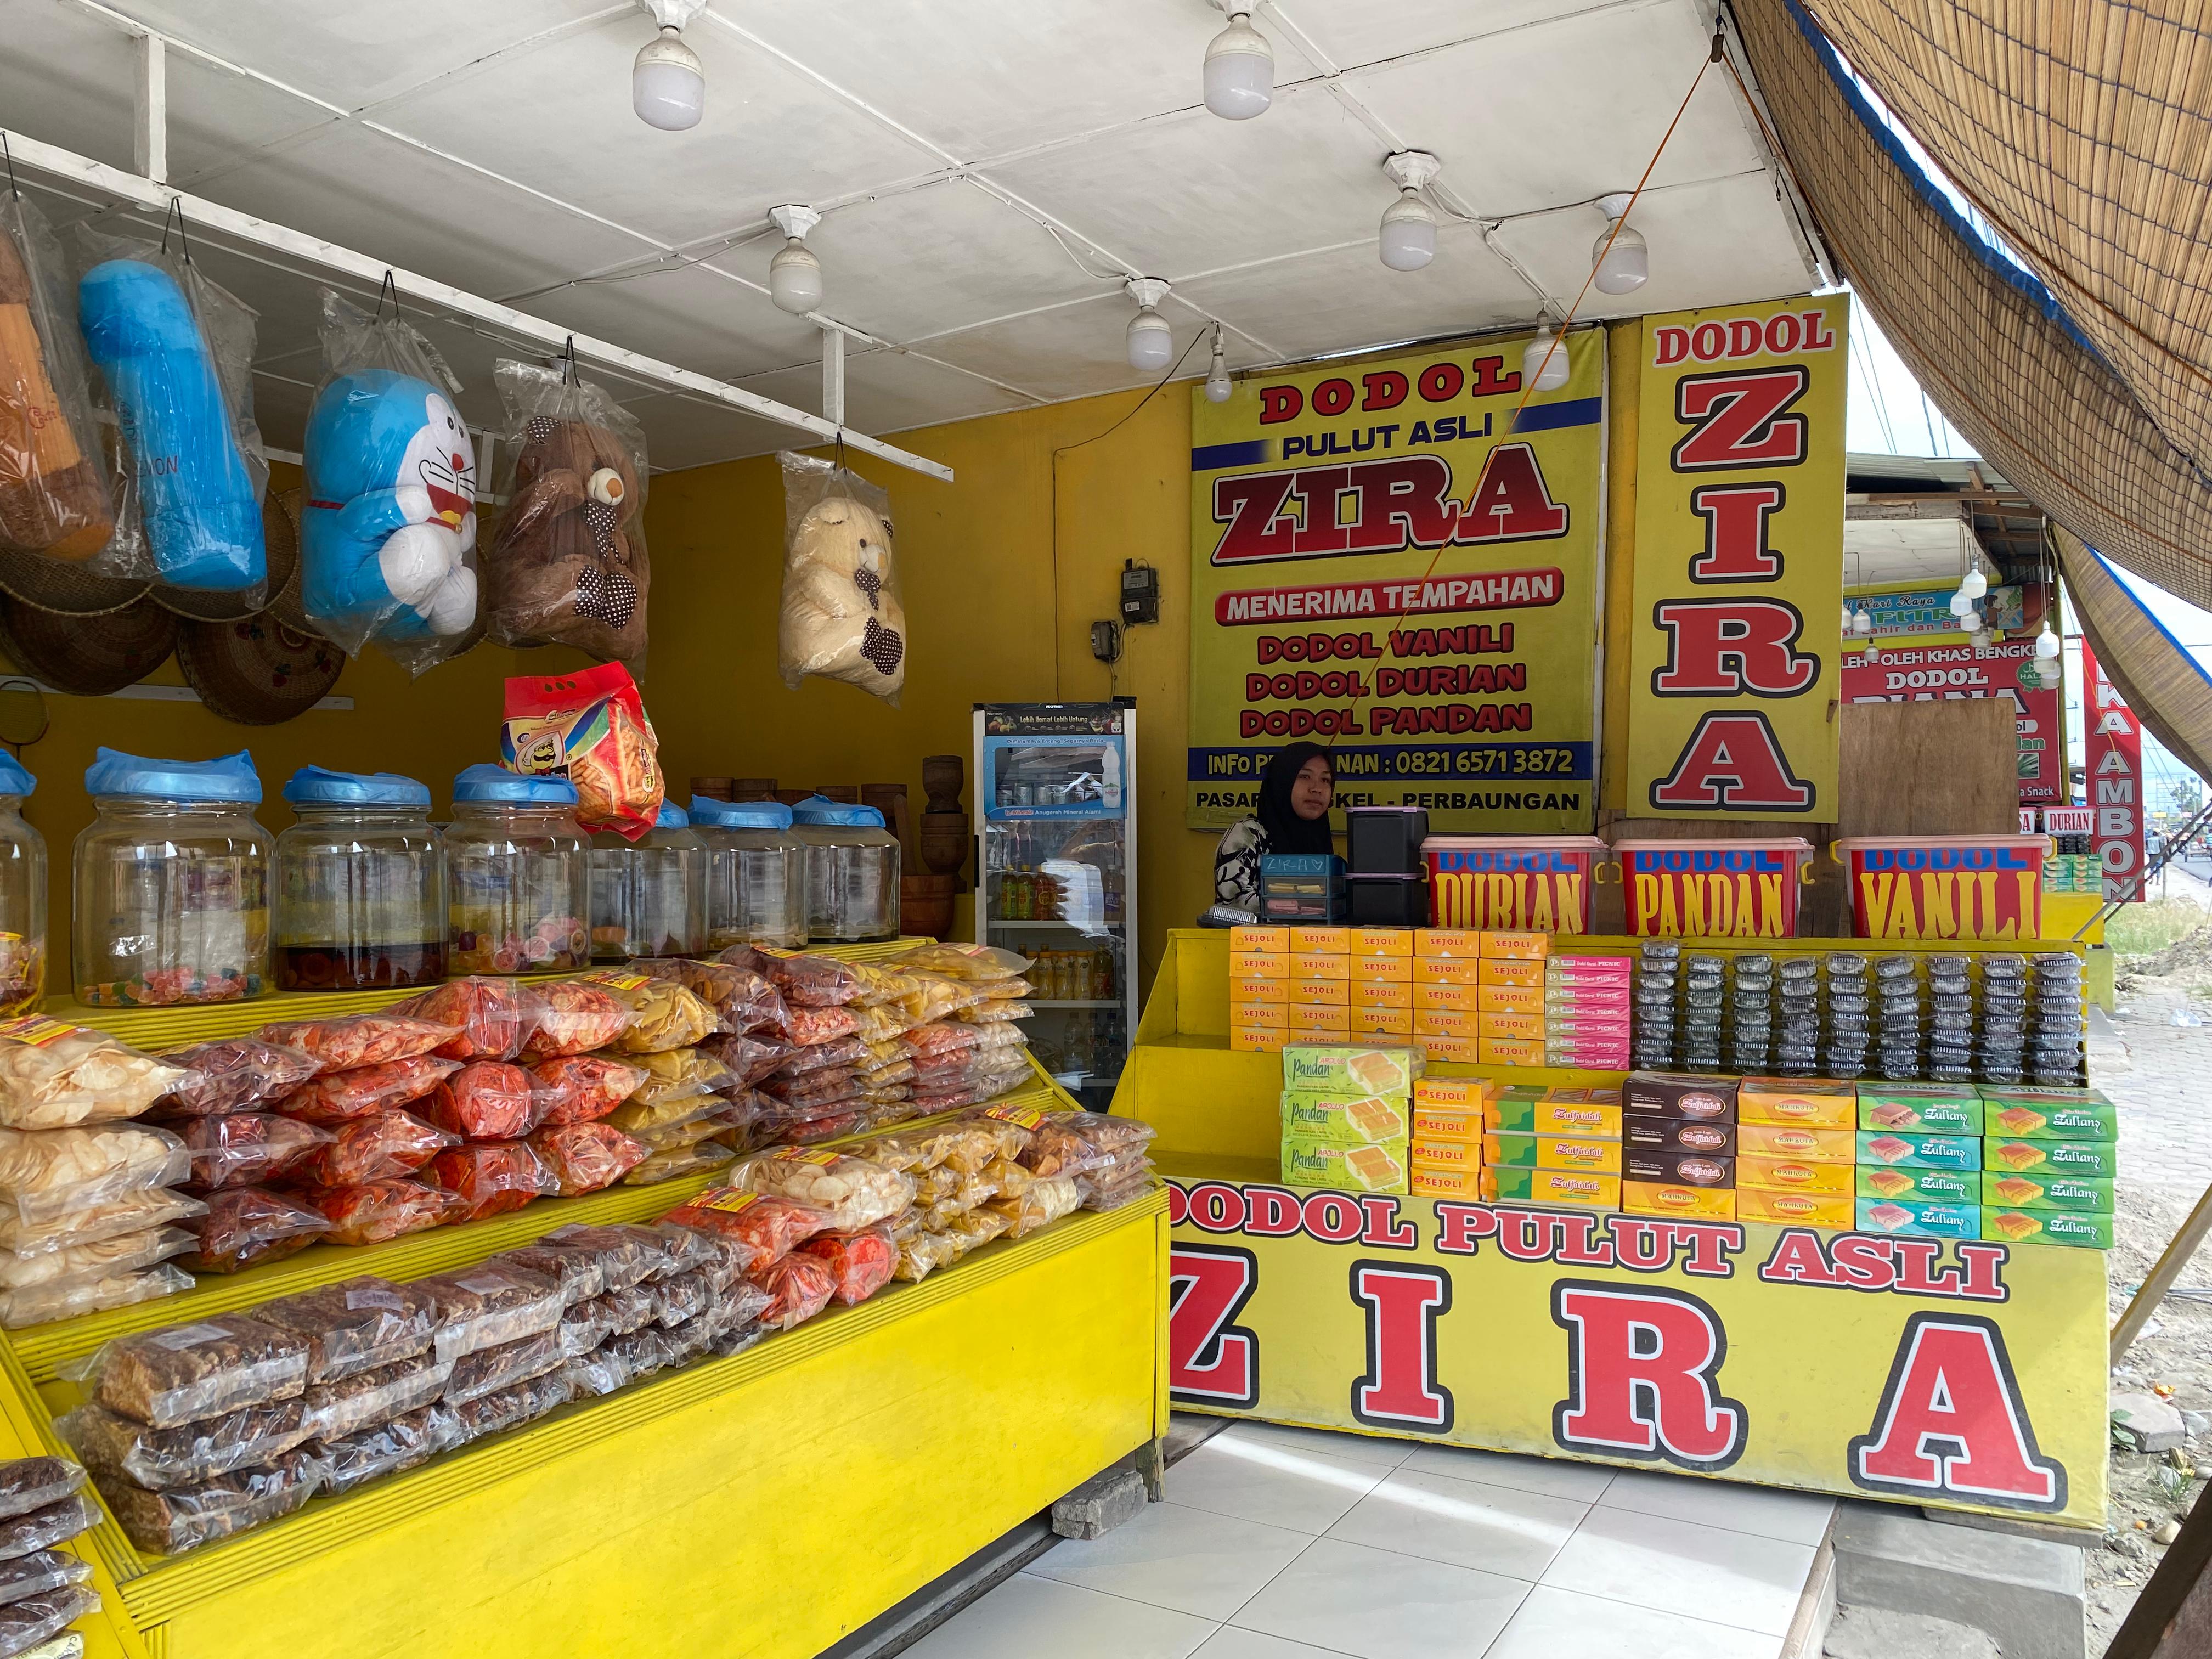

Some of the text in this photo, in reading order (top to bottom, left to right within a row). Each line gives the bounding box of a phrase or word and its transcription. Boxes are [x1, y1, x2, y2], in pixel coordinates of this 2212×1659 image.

[1654, 309, 1835, 367] DODOL
[1259, 355, 1522, 425] DODOL
[1283, 413, 1492, 460] PULUT ASLI
[1210, 443, 1570, 567] ZIRA
[1227, 574, 1554, 620] MENERIMA TEMPAHAN
[1649, 364, 1821, 812] ZIRA
[1897, 596, 1935, 607] Raya
[1861, 625, 1900, 635] ahir
[1908, 623, 1934, 631] dan
[1872, 607, 1961, 625] FITR
[1257, 622, 1515, 665] DODOL VANILI
[1842, 656, 1868, 669] LEH
[1881, 652, 1926, 666] OLEH
[1927, 648, 1971, 663] KHAS
[1975, 645, 2037, 660] BENGKE
[1246, 663, 1527, 702] DODOL DURIAN
[1886, 667, 1989, 690] DODOL
[1240, 702, 1532, 738] DODOL PANDAN
[1208, 753, 1250, 775] INFO
[1396, 751, 1450, 774] 0821
[1456, 750, 1507, 773] 6571
[1513, 749, 1573, 773] 3872
[1403, 793, 1579, 810] PERBAUNGAN
[2027, 786, 2054, 797] Snack
[2050, 812, 2089, 831] DURIAN
[1435, 873, 1583, 934] DURIAN
[1634, 873, 1784, 938] PANDAN
[1859, 871, 2037, 939] VANILI
[1494, 1047, 1527, 1056] SEJOLI
[1293, 1056, 1330, 1082] Pandan
[1429, 1092, 1465, 1101] SEJOLI
[1291, 1100, 1328, 1126] Pandan
[1429, 1122, 1465, 1131] SEJOLI
[1290, 1147, 1328, 1172] Pandan
[1426, 1150, 1463, 1160] SEJOLI
[1425, 1178, 1462, 1188] SEJOLI
[1435, 1200, 1746, 1278] PULUT
[1758, 1228, 2010, 1303] ASLI
